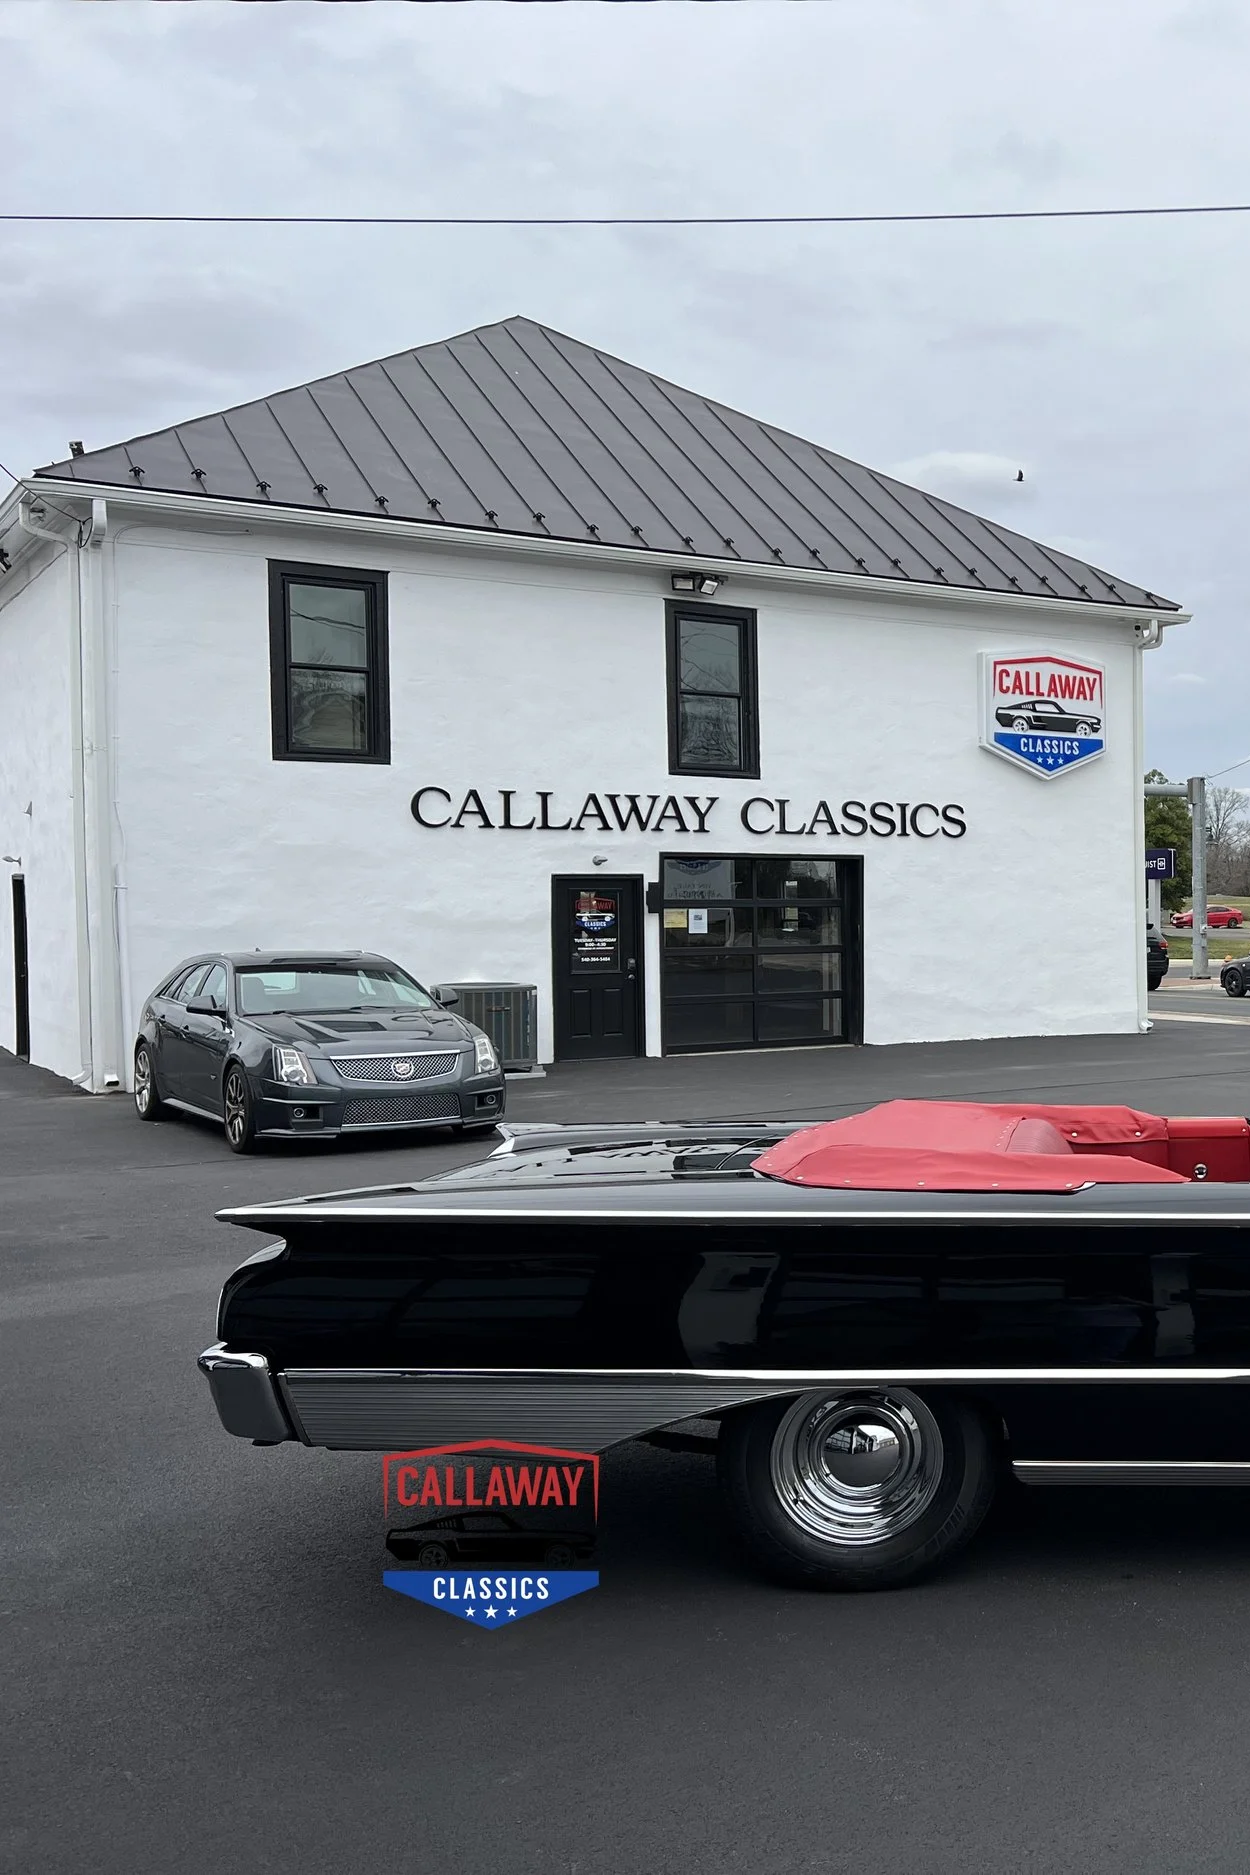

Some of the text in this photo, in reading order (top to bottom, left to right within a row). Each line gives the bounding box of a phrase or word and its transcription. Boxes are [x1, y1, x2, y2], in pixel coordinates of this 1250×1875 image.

[998, 669, 1097, 701] CALLAWAY
[1020, 738, 1080, 755] CLASSICS
[410, 786, 967, 838] CALLAWAY CLASSICS
